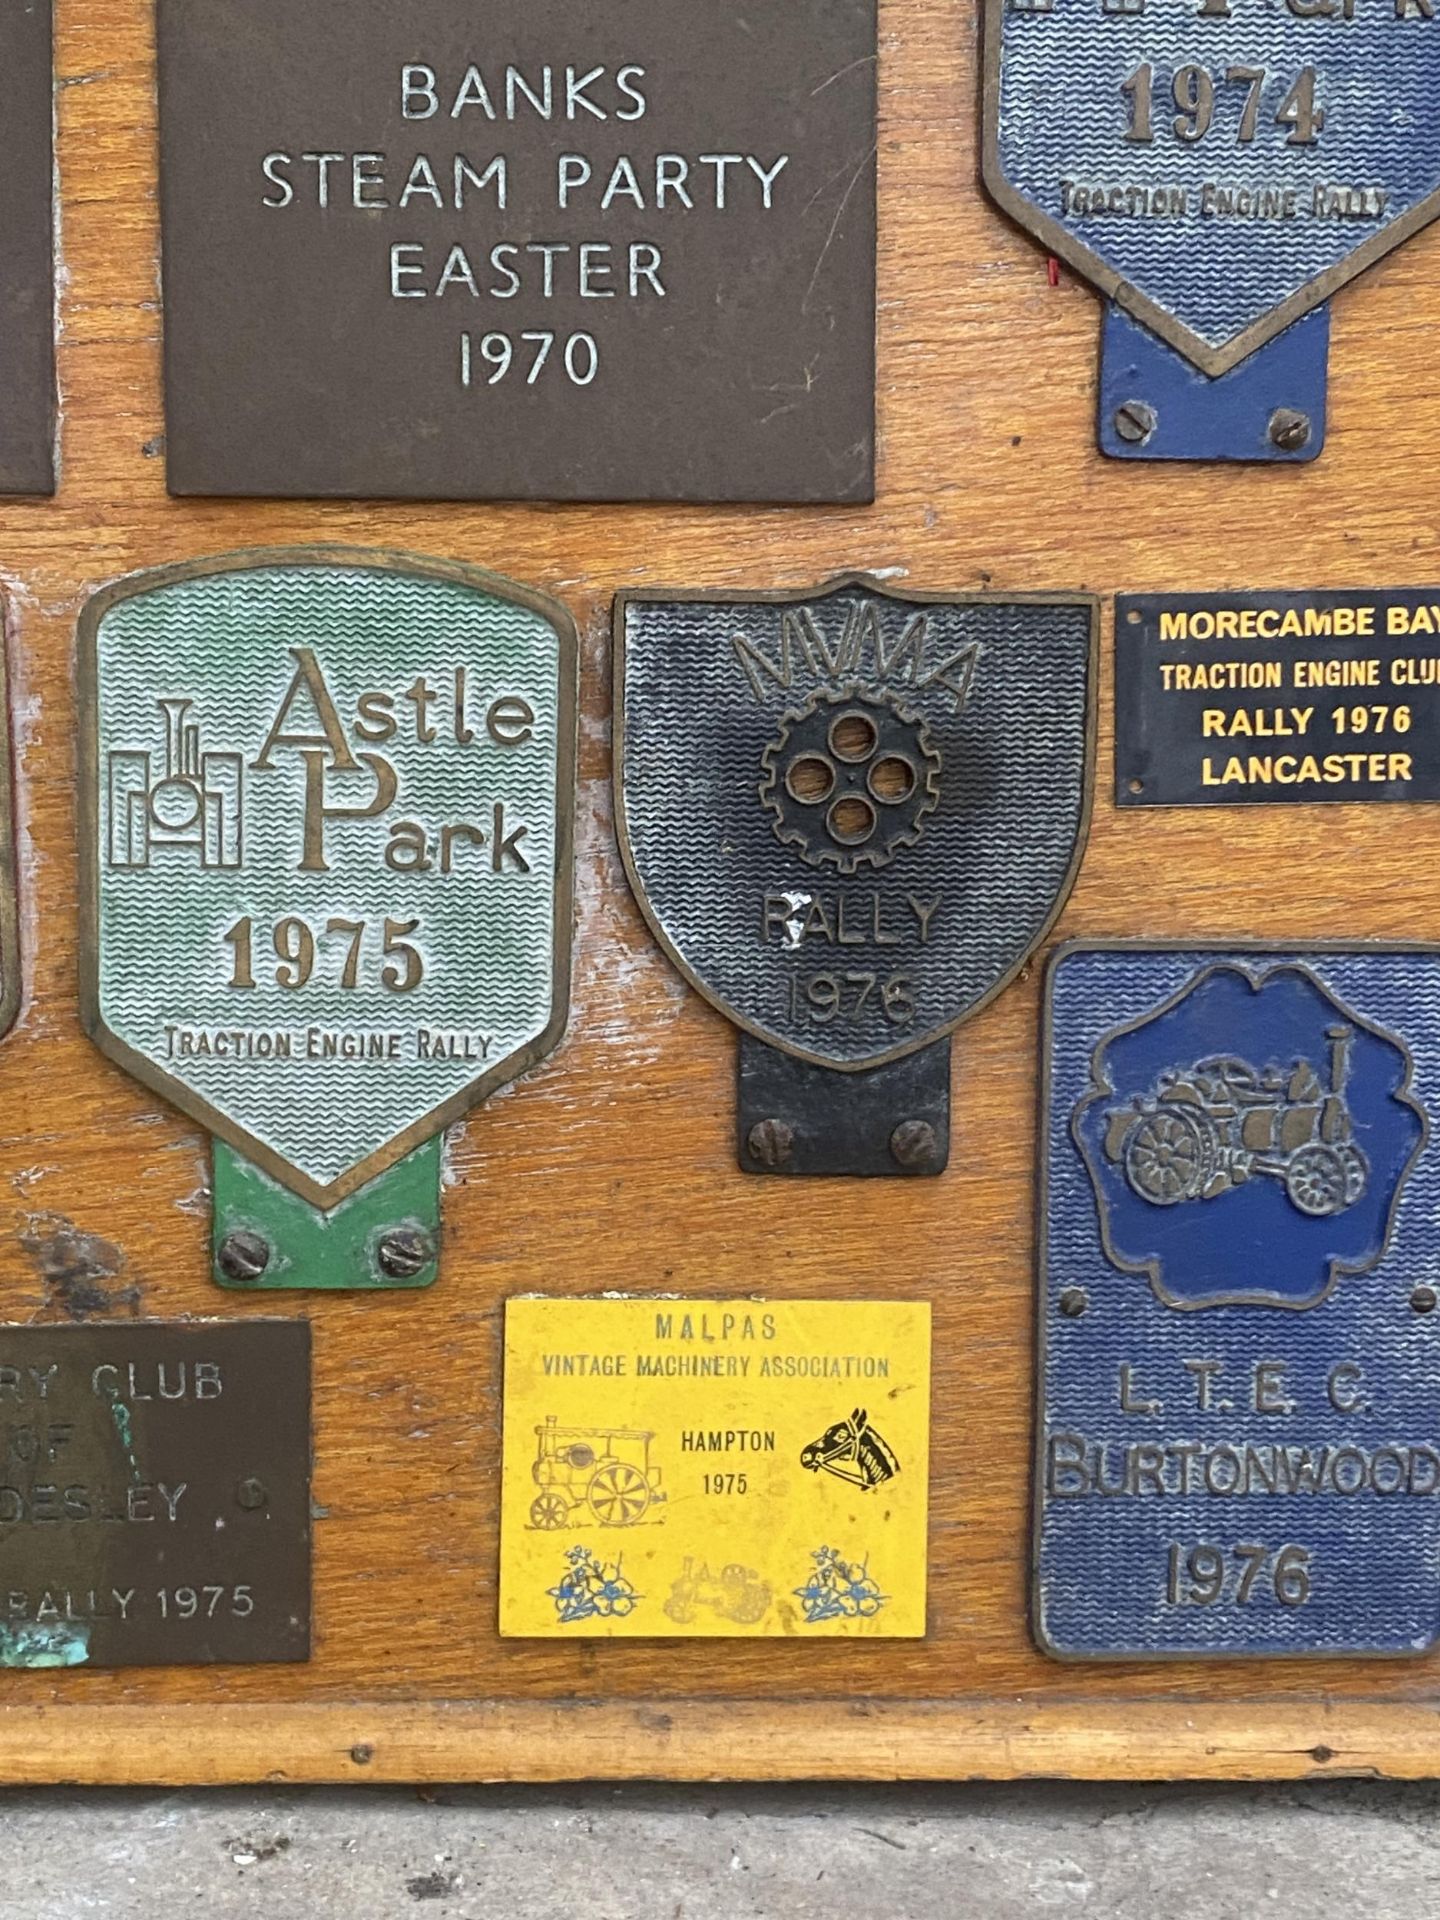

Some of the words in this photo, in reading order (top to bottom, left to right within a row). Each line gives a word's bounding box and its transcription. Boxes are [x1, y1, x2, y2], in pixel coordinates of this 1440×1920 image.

[401, 63, 647, 121] BANKS
[1119, 62, 1325, 146] 1974
[262, 152, 507, 209] STEAM
[557, 153, 790, 210] PARTY
[1059, 179, 1188, 218] TRACTION
[1202, 181, 1297, 218] ENGINE
[1312, 183, 1387, 219] RALLY
[390, 243, 666, 298] EASTER
[461, 331, 599, 386] 1970
[1159, 607, 1376, 641] MORECAMBE
[1159, 661, 1282, 690] TRACTION
[1294, 659, 1381, 688] ENGINE
[1391, 658, 1440, 685] CLU
[250, 647, 536, 770] Astle
[1202, 706, 1315, 738] RALLY
[1331, 705, 1412, 735] 1976
[1202, 753, 1413, 786] LANCASTER
[298, 750, 531, 873] Park
[763, 892, 944, 944] RALLY
[223, 915, 425, 993] 1975
[787, 972, 916, 1023] 1976
[163, 1025, 291, 1058] TRACTION
[306, 1026, 400, 1059] ENGINE
[416, 1028, 494, 1059] RALLY
[655, 1313, 777, 1341] MALPAS
[92, 1362, 223, 1400] CLUB
[542, 1354, 627, 1377] VINTAGE
[636, 1354, 751, 1378] MACHINERY
[759, 1355, 890, 1378] ASSOCIATION
[681, 1430, 776, 1452] HAMPTON
[702, 1473, 748, 1495] 1975
[1048, 1434, 1440, 1497] BURTONWOOD
[1165, 1542, 1312, 1606] 1976
[157, 1585, 255, 1619] 1975
